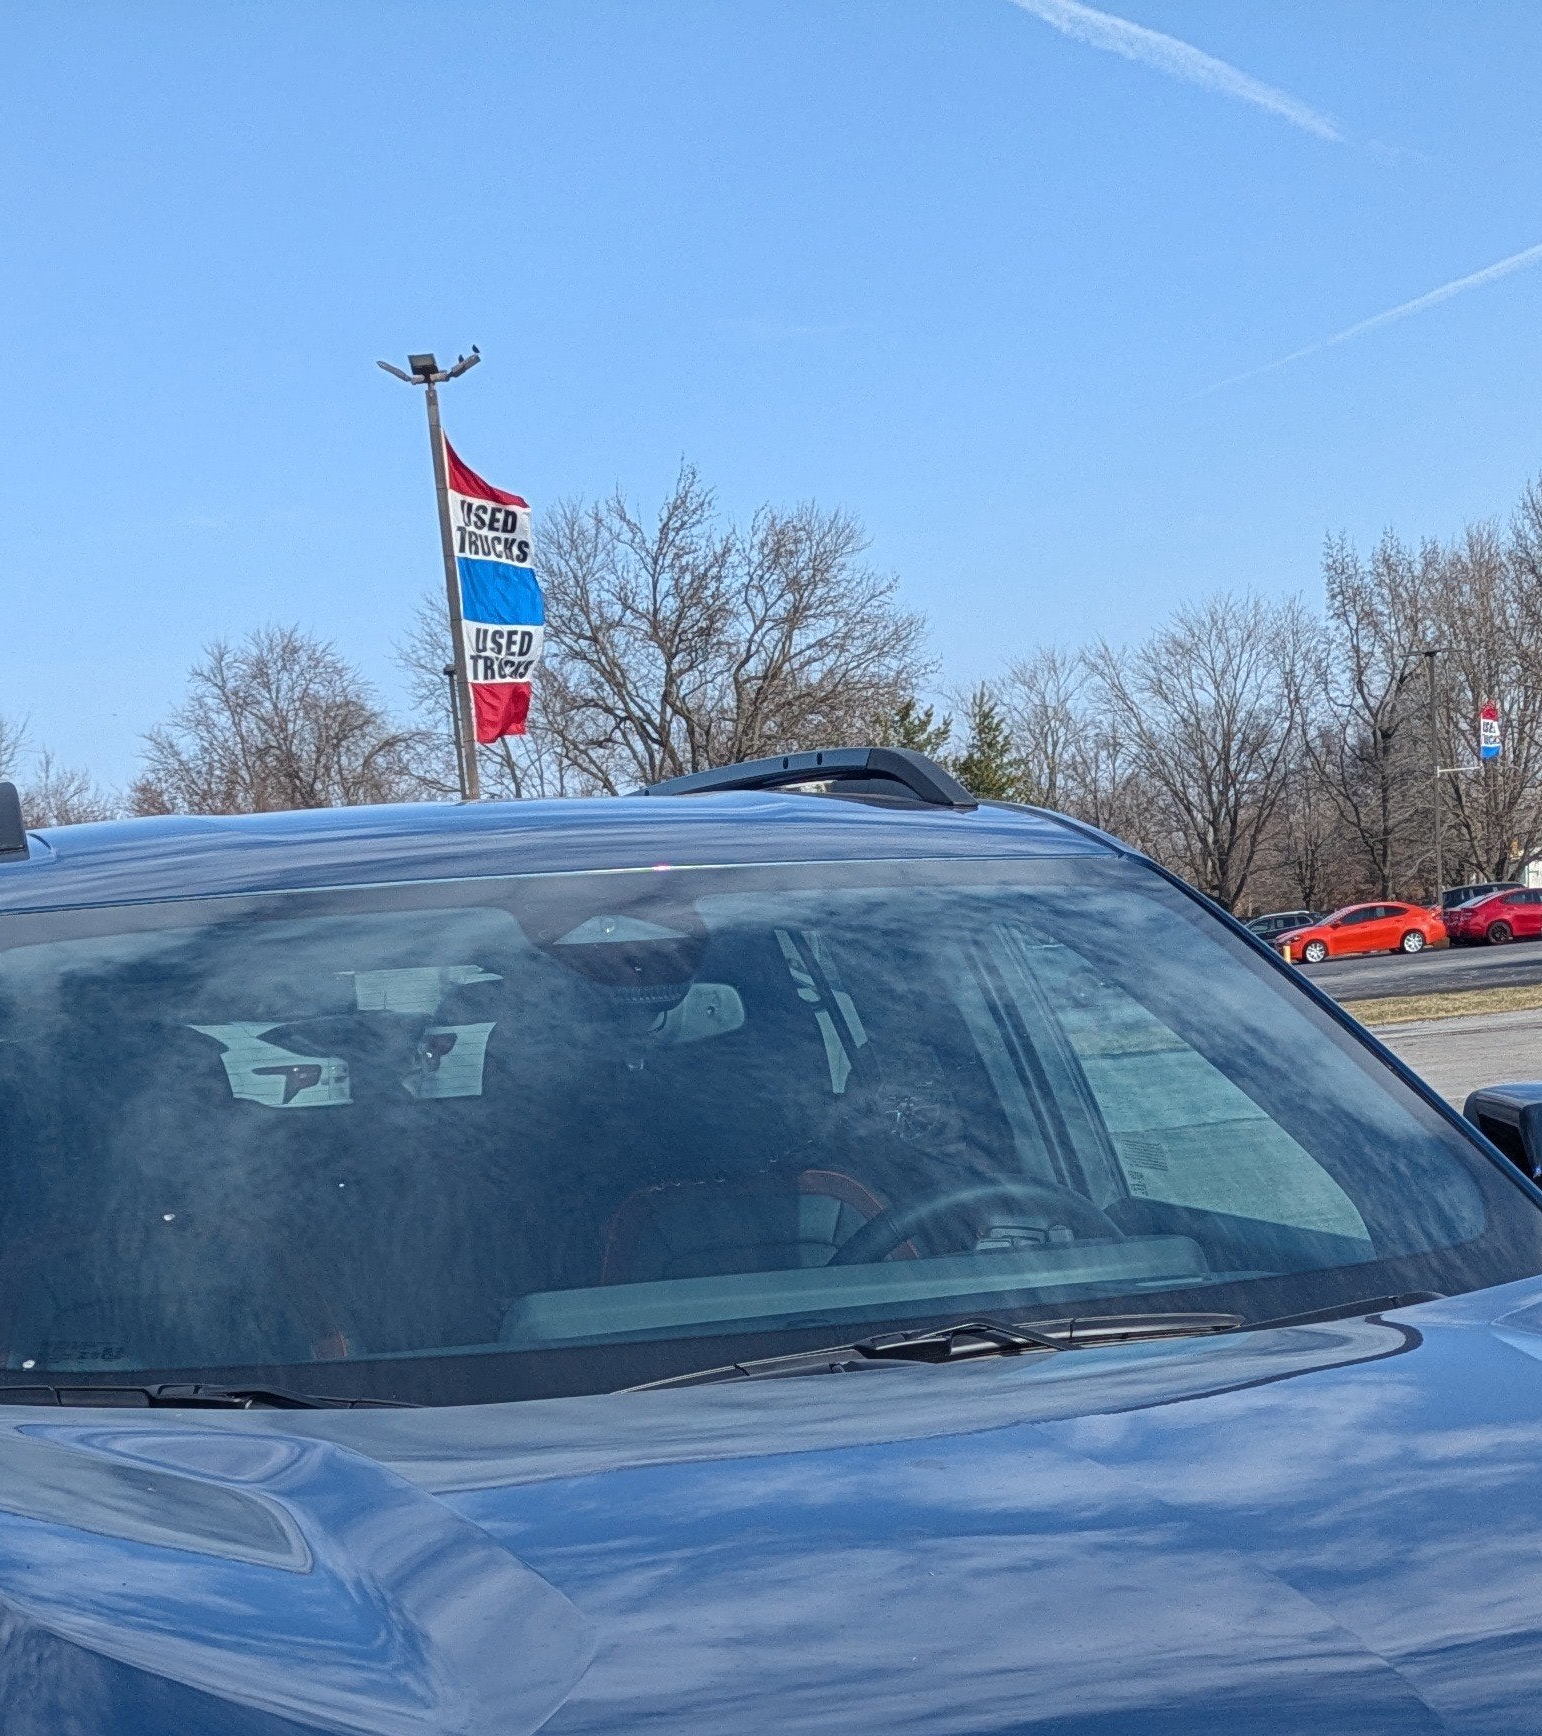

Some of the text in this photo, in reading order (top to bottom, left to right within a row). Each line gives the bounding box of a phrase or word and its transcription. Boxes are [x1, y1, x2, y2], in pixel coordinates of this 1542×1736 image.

[460, 499, 518, 533] USED
[456, 526, 530, 563] TRUCKS
[475, 628, 533, 657] USED
